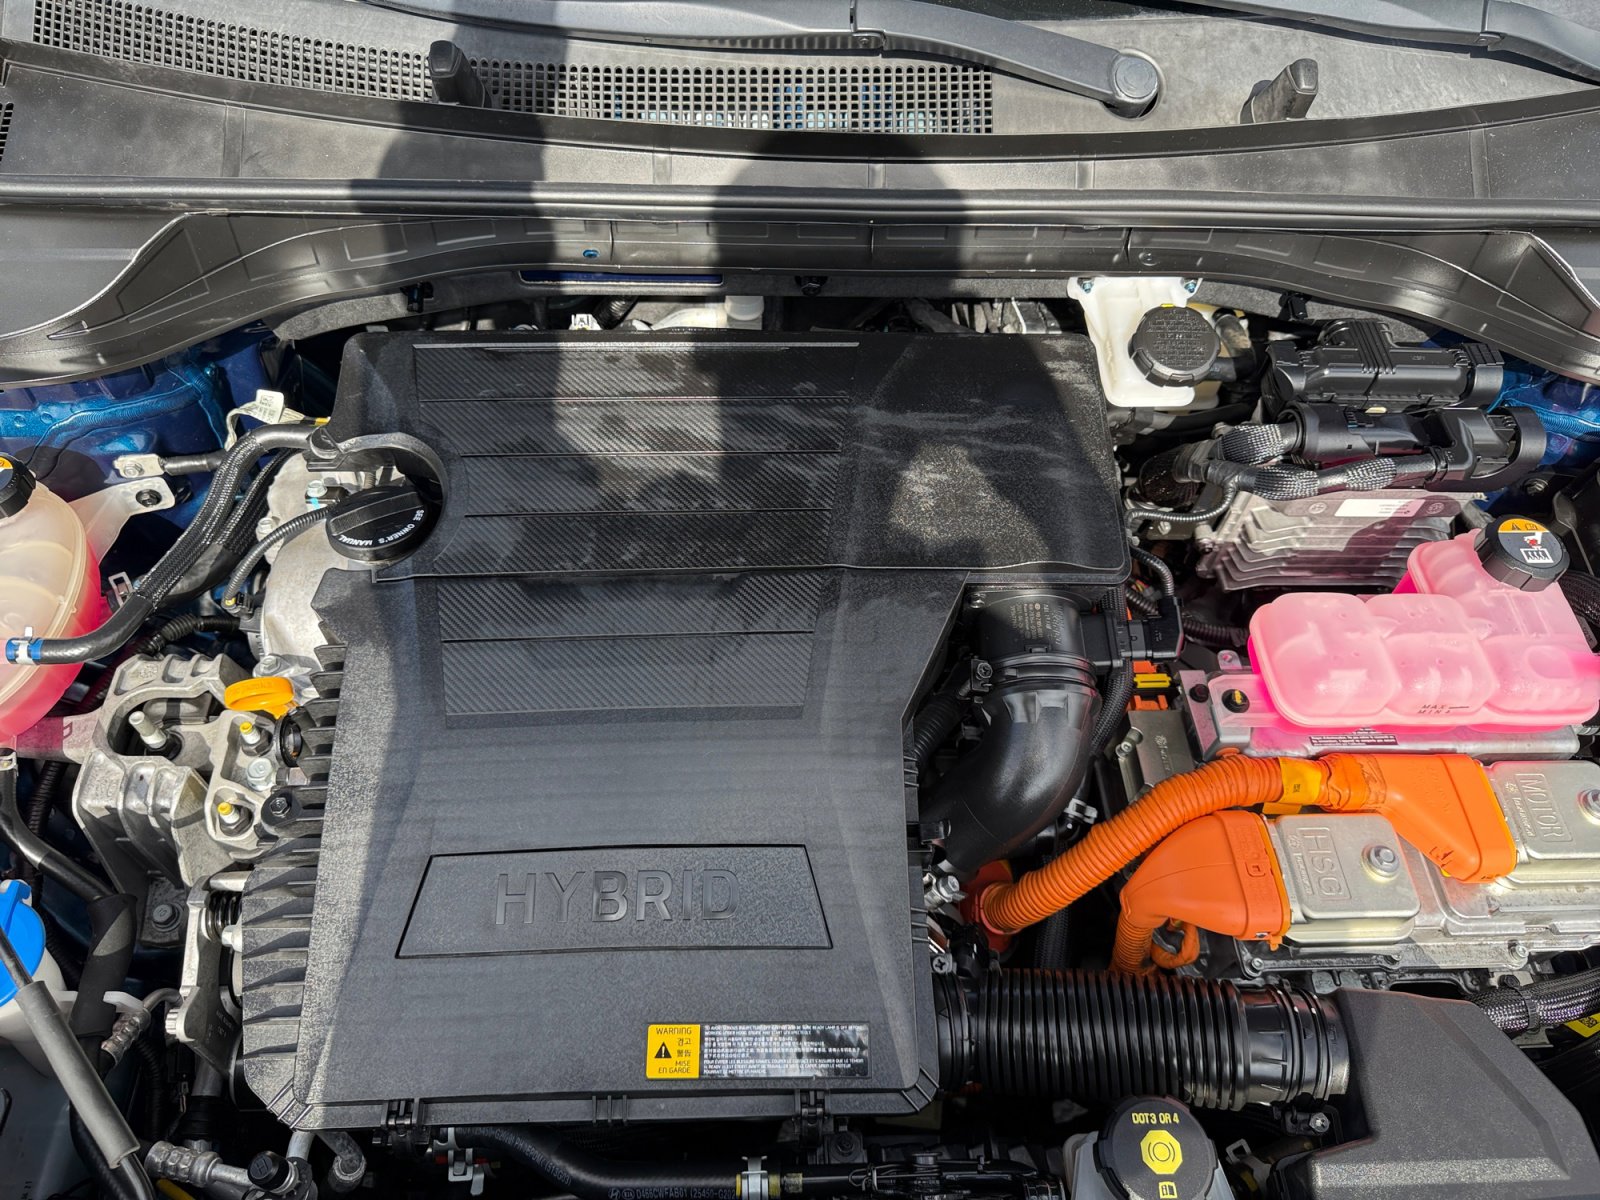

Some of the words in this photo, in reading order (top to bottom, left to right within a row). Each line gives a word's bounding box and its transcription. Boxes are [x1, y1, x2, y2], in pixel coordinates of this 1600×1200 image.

[413, 509, 425, 521] SEE
[378, 523, 415, 544] OWNER'S
[338, 534, 373, 546] MANUAL
[1519, 779, 1563, 837] MOTOR
[1303, 835, 1343, 896] HSG
[495, 868, 741, 925] HYBRID
[656, 1027, 692, 1035] WARNING
[678, 1037, 692, 1047] 경고
[1132, 1112, 1157, 1124] DOT3
[1158, 1112, 1172, 1124] OR
[1172, 1112, 1180, 1124] 4
